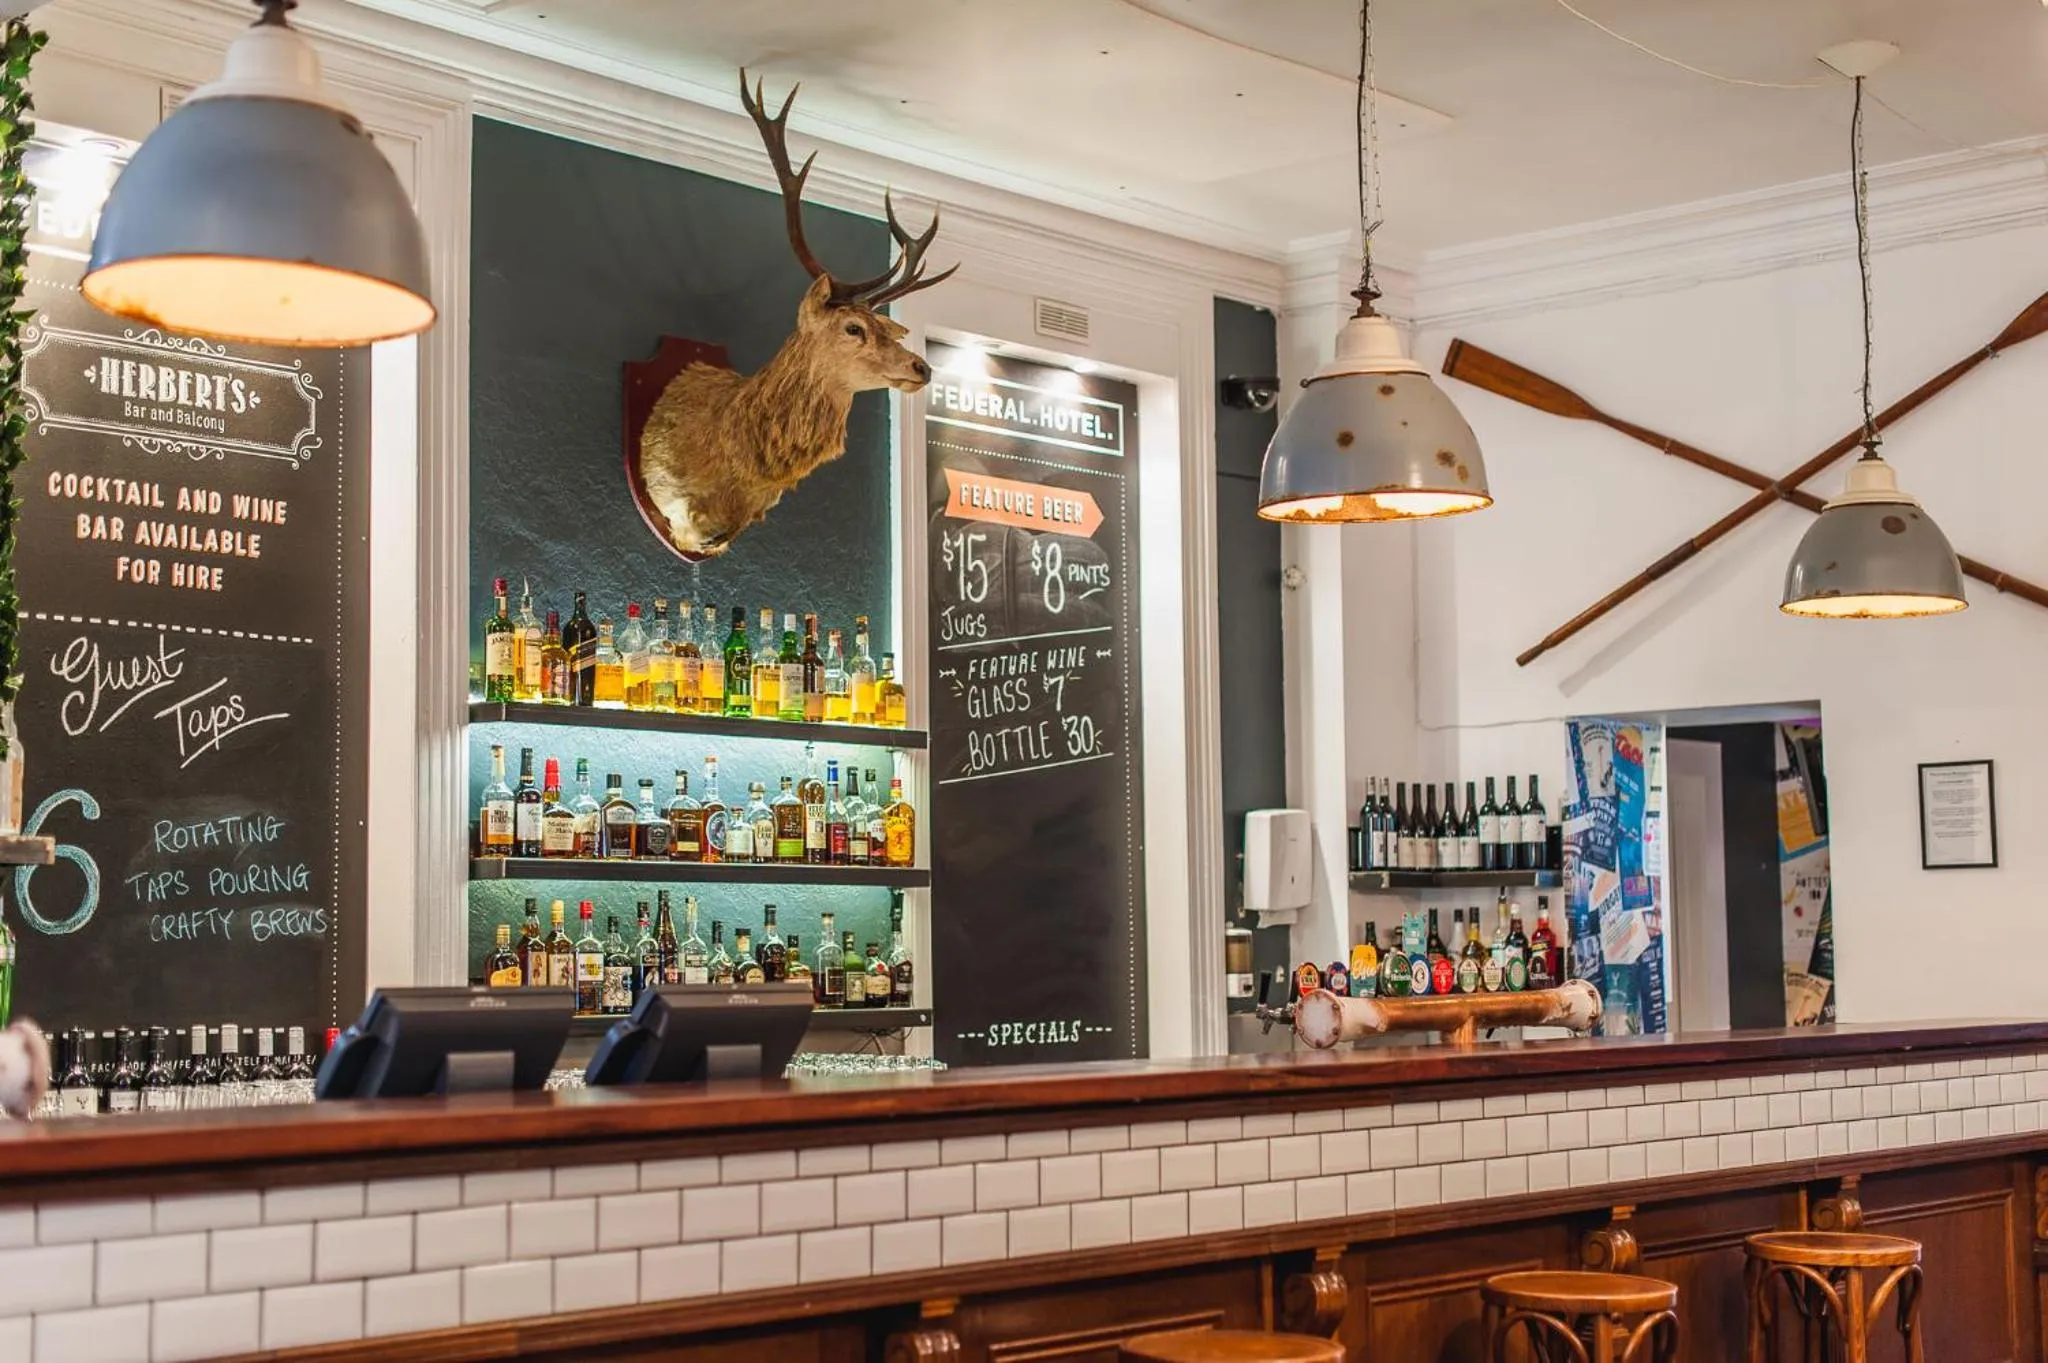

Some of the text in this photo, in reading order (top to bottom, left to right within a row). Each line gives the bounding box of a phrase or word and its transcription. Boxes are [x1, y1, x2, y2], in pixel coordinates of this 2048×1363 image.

[100, 356, 248, 414] HERBERT'S
[124, 401, 225, 433] Bar and Balcony
[48, 471, 288, 525] COCKTAIL AND WINE
[959, 483, 1084, 525] FEATURE BEER
[76, 513, 261, 559] BAR AVAILABLE
[116, 556, 224, 592] FOR HIRE
[942, 530, 989, 602] $15
[1068, 562, 1111, 586] PINTS
[968, 646, 1087, 680] FEATURE WINE
[154, 677, 247, 756] Taps
[967, 673, 1065, 719] GLASS $7
[968, 715, 1095, 771] BOTTLE $30
[154, 815, 286, 852] ROTATING
[15, 788, 101, 934] 6
[125, 863, 311, 902] TAPS POURING
[151, 908, 328, 941] CRAFTY BREWS
[987, 1020, 1081, 1046] SPECIALS
